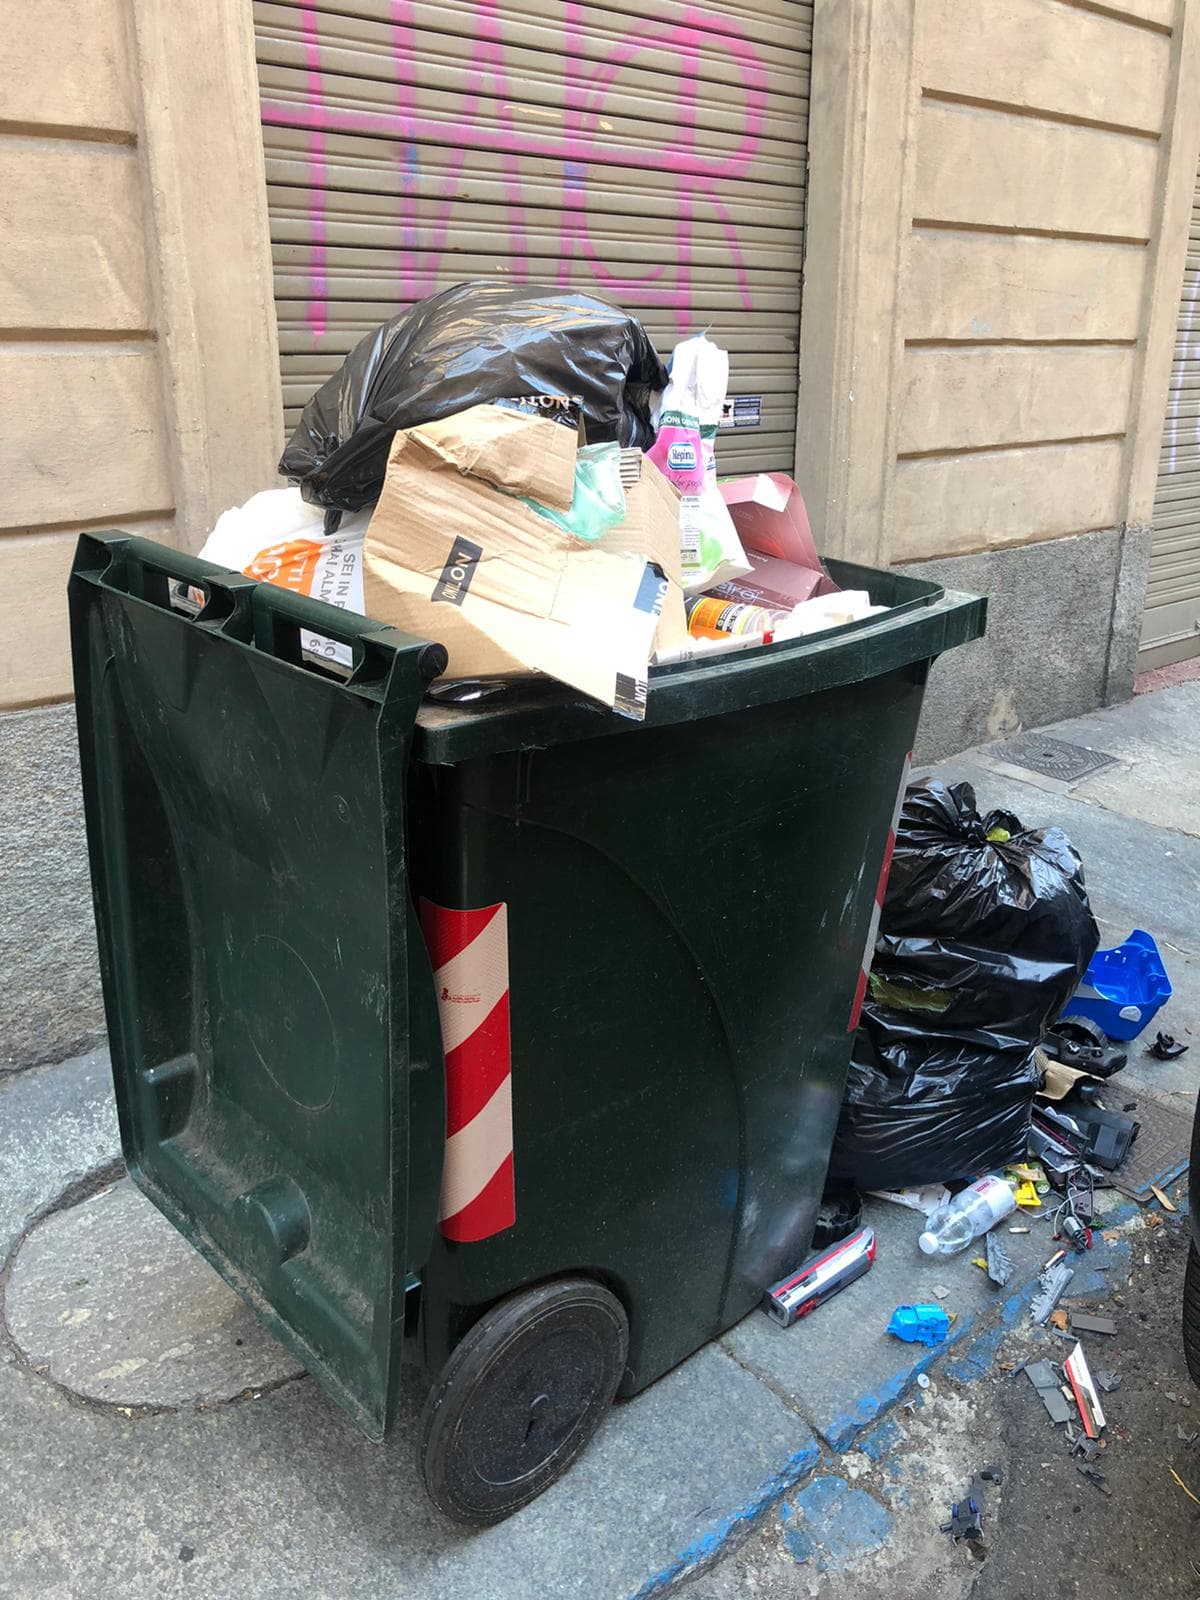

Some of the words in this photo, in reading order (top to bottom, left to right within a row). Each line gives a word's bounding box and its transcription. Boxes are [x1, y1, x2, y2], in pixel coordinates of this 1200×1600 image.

[341, 553, 356, 576] SEI
[319, 571, 336, 604] ALM
[337, 580, 350, 595] IN
